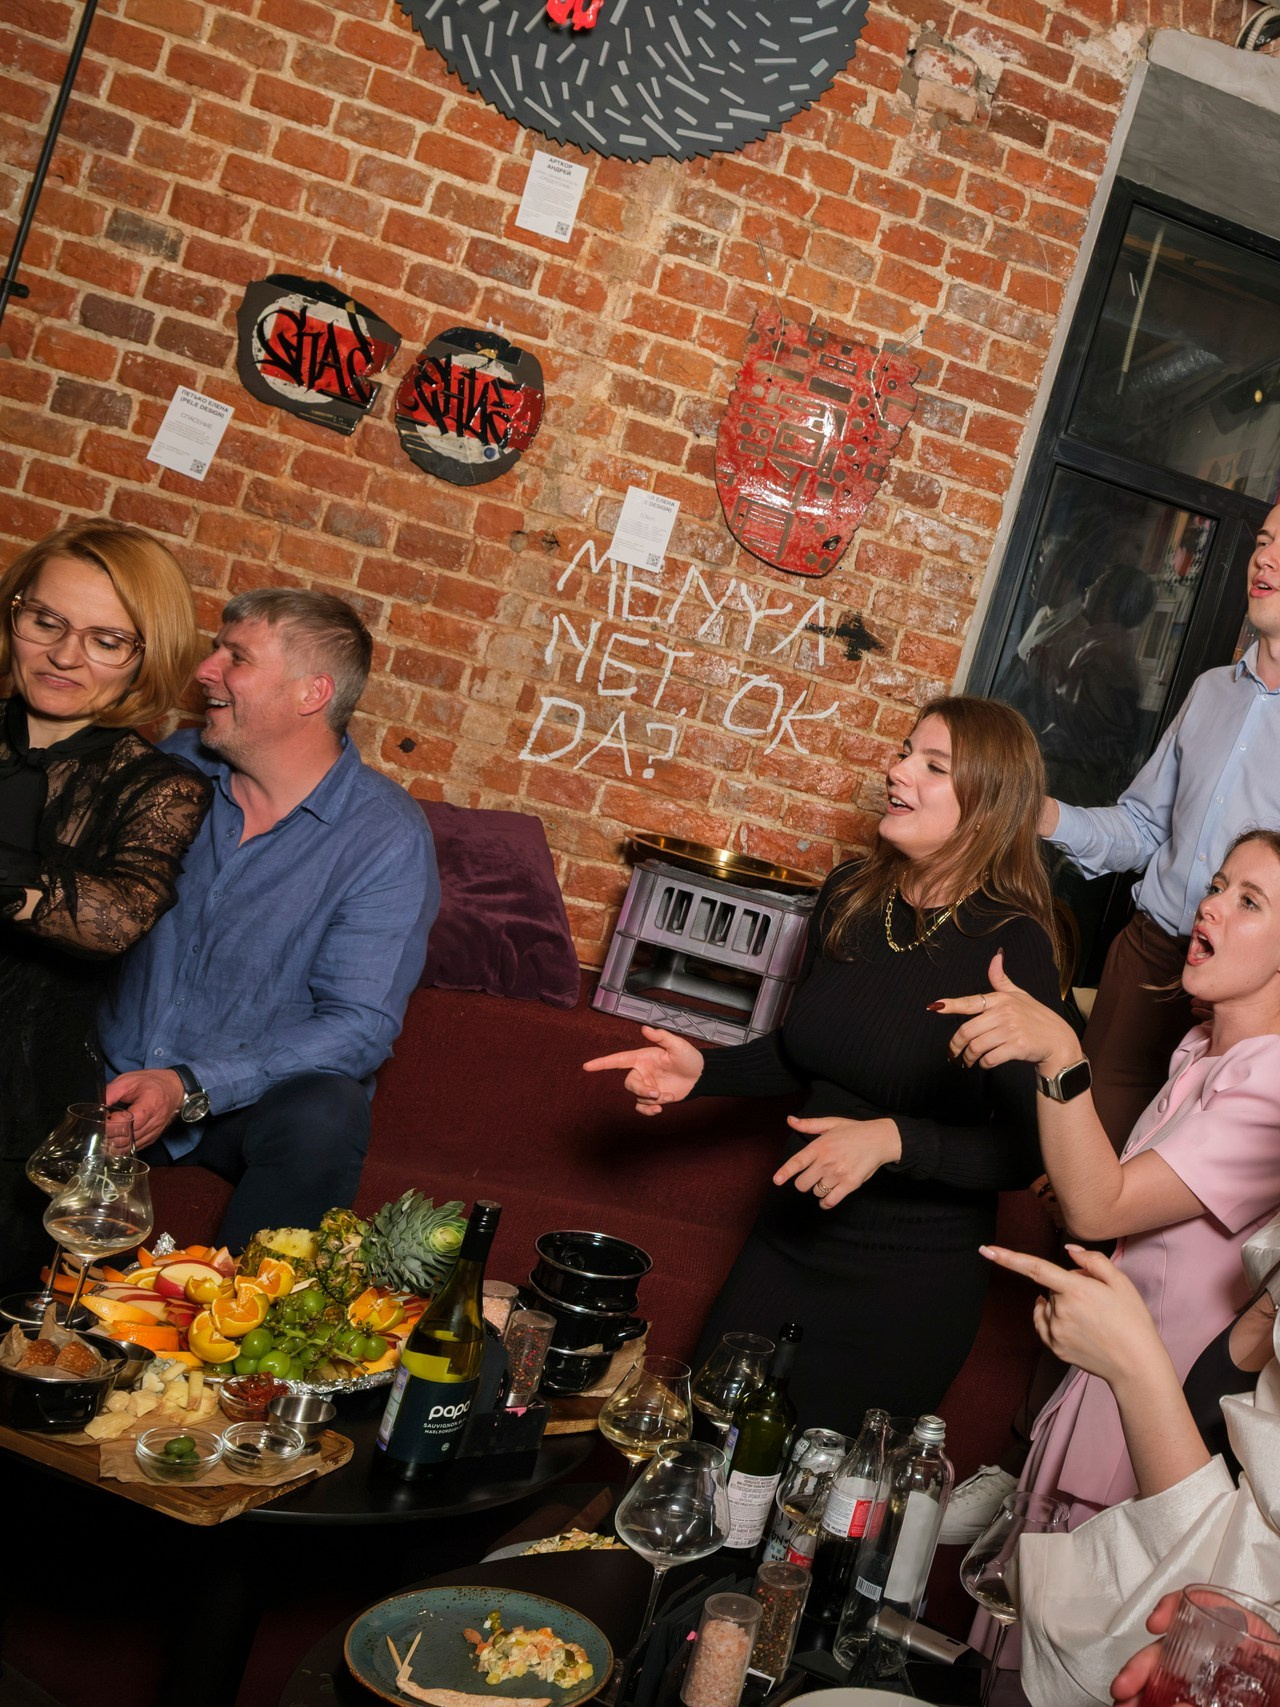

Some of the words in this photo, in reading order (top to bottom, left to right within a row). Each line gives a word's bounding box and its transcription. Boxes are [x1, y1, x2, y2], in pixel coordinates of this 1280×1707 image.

[547, 164, 571, 176] АНДРЕЙ
[181, 389, 207, 404] ПЕТЬКО
[208, 400, 229, 413] ЕЛЕНА
[723, 667, 840, 755] OK
[518, 697, 678, 779] DA?
